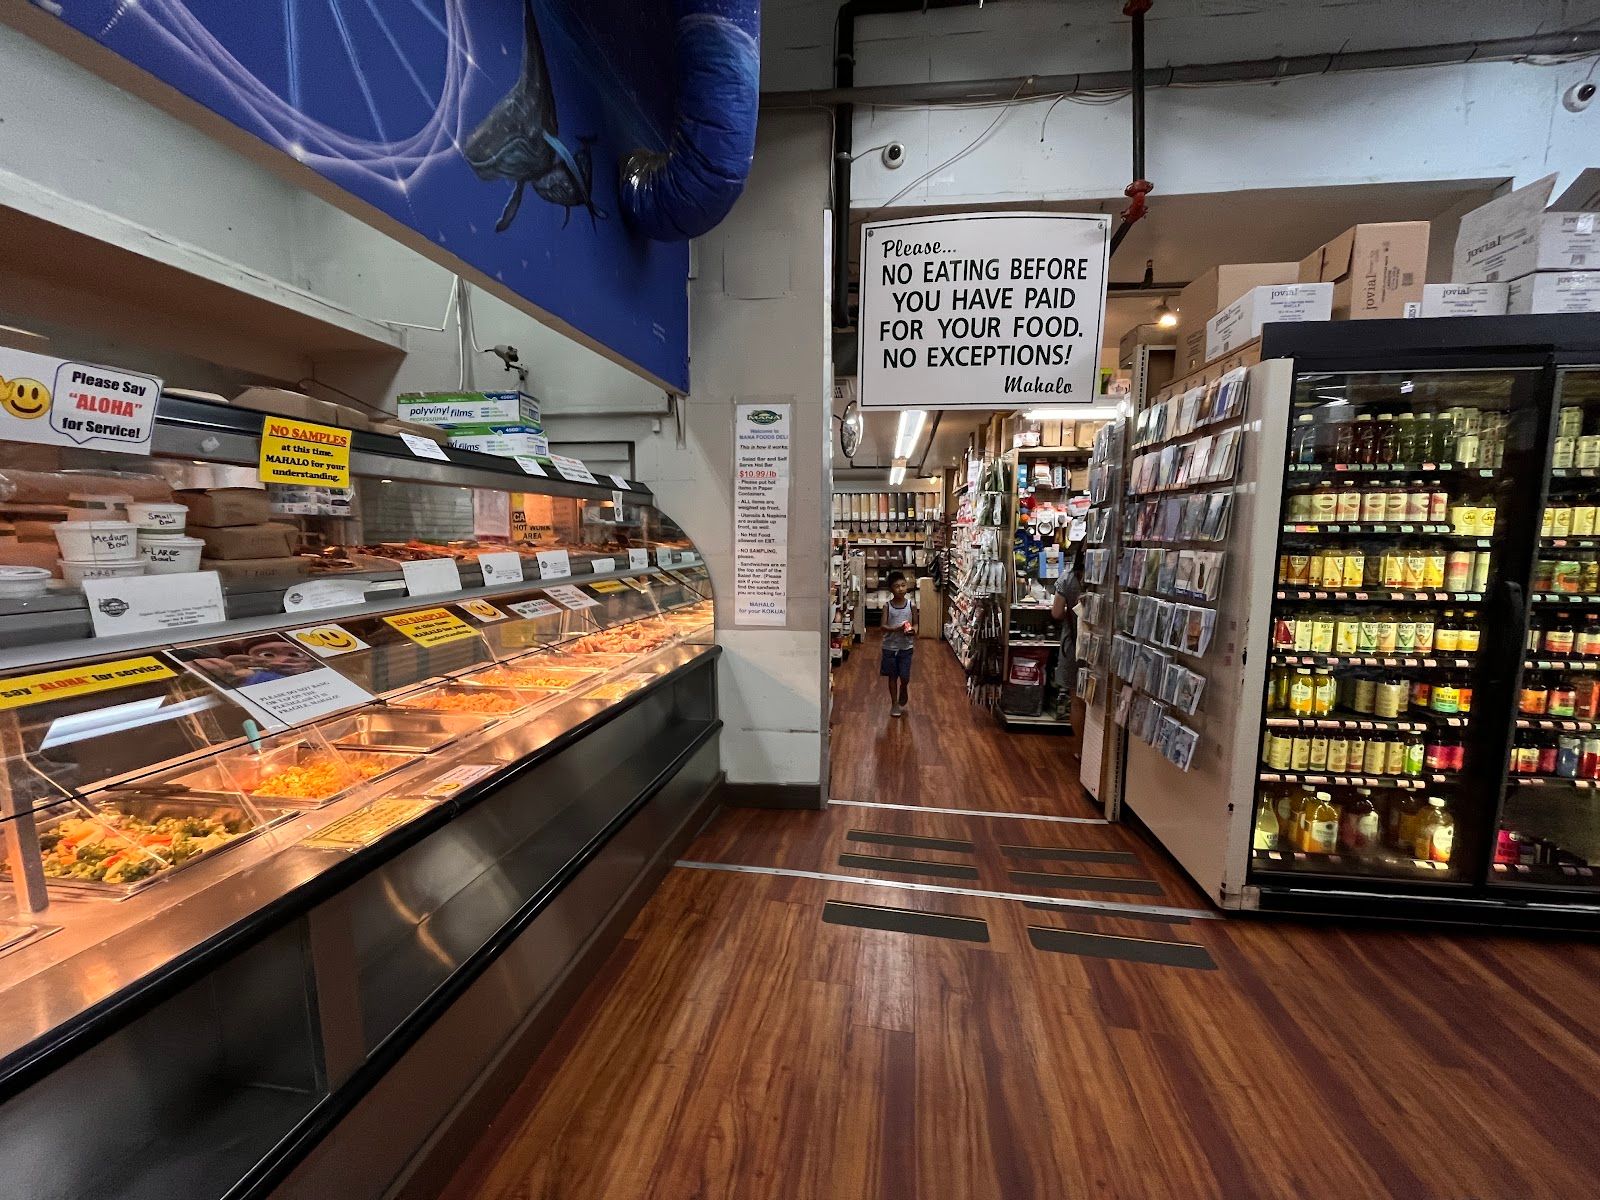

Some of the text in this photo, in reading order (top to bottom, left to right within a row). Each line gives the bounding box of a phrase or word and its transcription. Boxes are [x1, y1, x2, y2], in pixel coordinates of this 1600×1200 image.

[882, 239, 957, 258] Please...
[1466, 235, 1502, 262] jovial
[882, 257, 1088, 286] NO EATING BEFORE
[892, 287, 1076, 312] YOU HAVE PAID
[1366, 273, 1378, 310] jovial
[1442, 287, 1470, 298] jovial
[880, 316, 1083, 342] FOR YOUR FOOD.
[884, 344, 1072, 369] NO EXCEPTIONS!
[72, 371, 146, 397] Please Say
[1004, 376, 1072, 394] Mahalo
[410, 406, 450, 416] polyvinyl
[450, 409, 474, 417] films
[62, 418, 140, 438] for Service!
[269, 424, 347, 446] NO SAMPLES
[293, 445, 310, 454] this
[312, 448, 334, 457] time.
[266, 454, 346, 472] MAHALO for your
[272, 468, 340, 482] understanding.
[148, 512, 172, 520] Small
[92, 534, 128, 543] Medium
[141, 547, 180, 556] X-LARGE
[392, 611, 450, 627] NO SAMPLES
[412, 628, 443, 638] MAHALO
[0, 686, 32, 698] say
[92, 672, 114, 682] for
[115, 664, 164, 678] service
[259, 692, 286, 701] PLEASE
